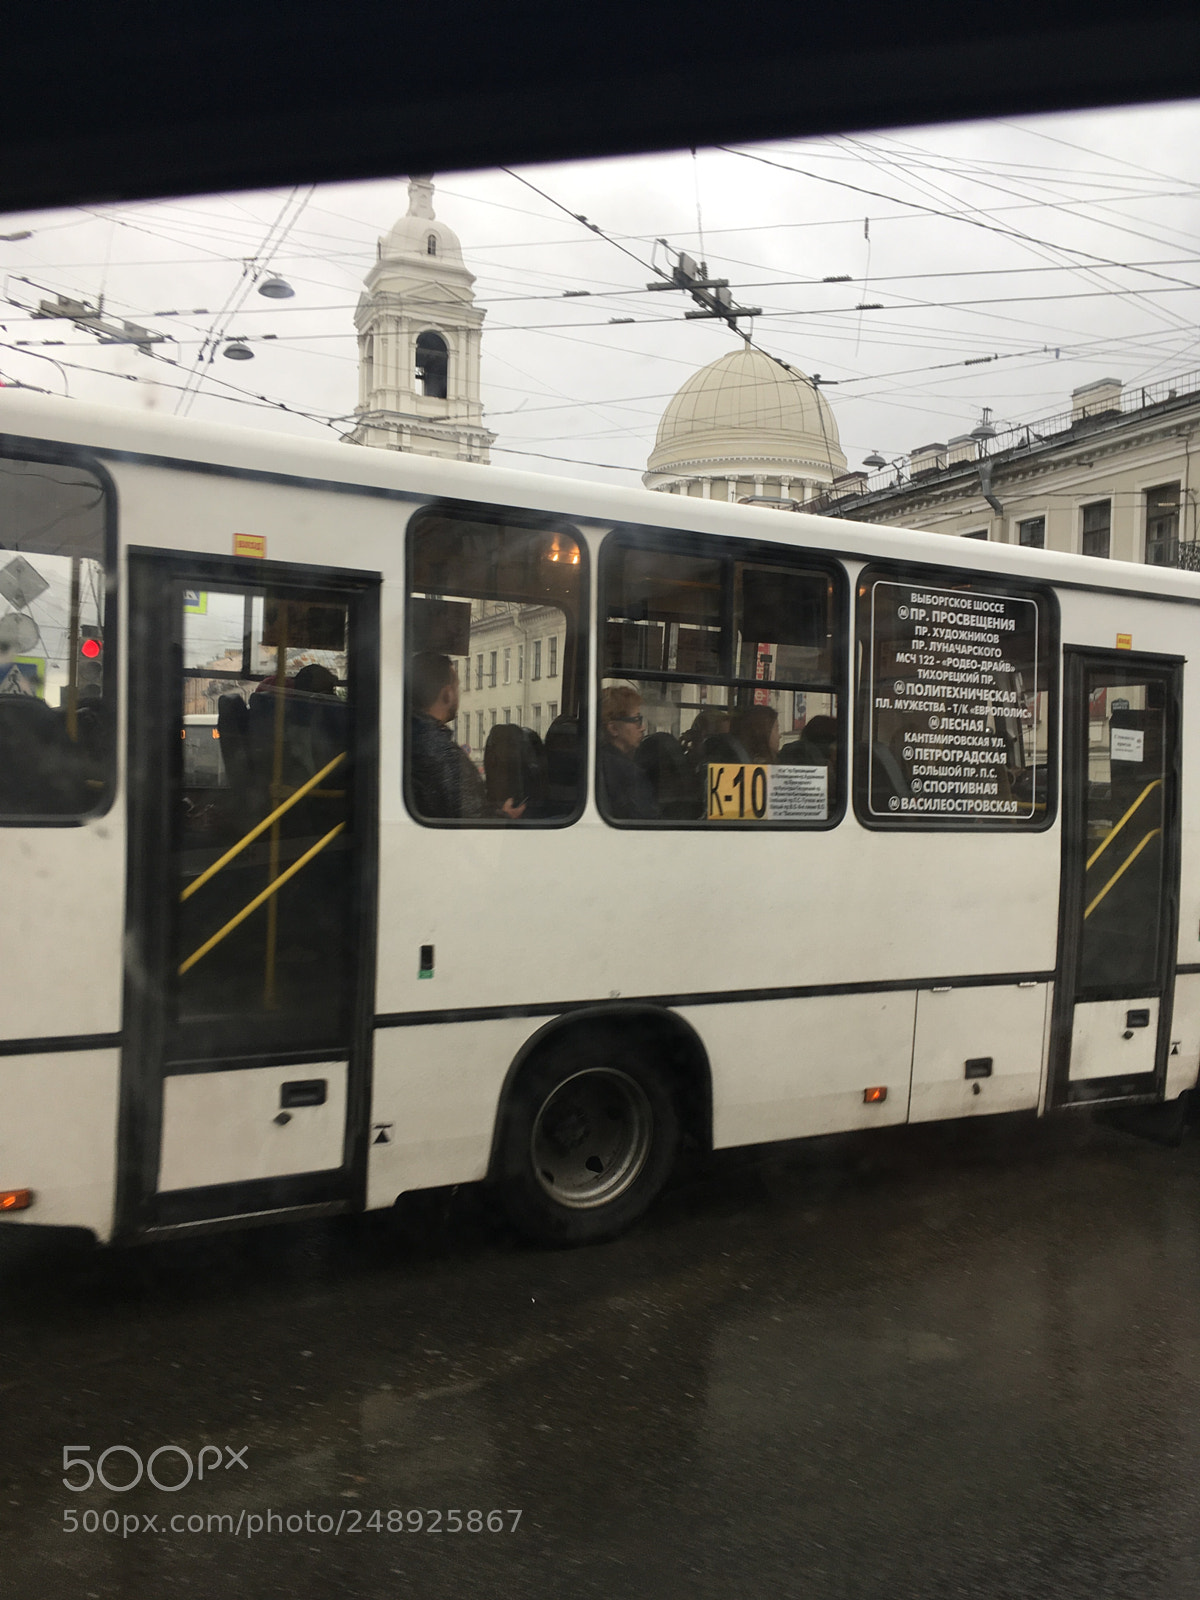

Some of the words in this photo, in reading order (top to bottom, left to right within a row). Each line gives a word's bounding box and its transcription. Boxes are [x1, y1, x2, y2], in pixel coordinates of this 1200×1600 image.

[911, 593, 973, 609] ВЫБОРГСКОЕ
[973, 600, 1004, 613] ШОССЕ
[910, 608, 930, 622] ПР.
[932, 611, 1016, 631] ПРОСВЕЩЕНИЯ
[915, 626, 930, 636] ПР.
[932, 627, 1000, 643] ХУДОЖНИКОВ
[912, 640, 928, 650] ПР.
[929, 641, 1002, 658] ЛУНАЧАРСКОГО
[896, 653, 916, 663] МСЧ
[919, 655, 935, 665] 122
[917, 669, 979, 683] ТИХОРЕЦКИЙ
[981, 675, 996, 685] ПР.
[906, 683, 1017, 703] ПОЛИТЕХНИЧЕСКАЯ
[875, 698, 892, 708] ПЛ.
[894, 699, 946, 712] МУЖЕСТВА
[953, 704, 968, 716] Т/К
[940, 718, 984, 731] ЛЕСНАЯ
[904, 732, 989, 747] КАНТЕМИРОВСКАЯ
[992, 737, 1006, 747] УЛ.
[915, 748, 1007, 764] ПЕТРОГРАДСКАЯ
[913, 765, 962, 776] БОЛЬШОЙ
[963, 767, 978, 777] ПР.
[980, 769, 997, 778] П.С.
[709, 766, 767, 818] К-10
[923, 780, 998, 795] СПОРТИВНАЯ
[901, 798, 1018, 813] ВАСИЛЕОСТРОВСКАЯ
